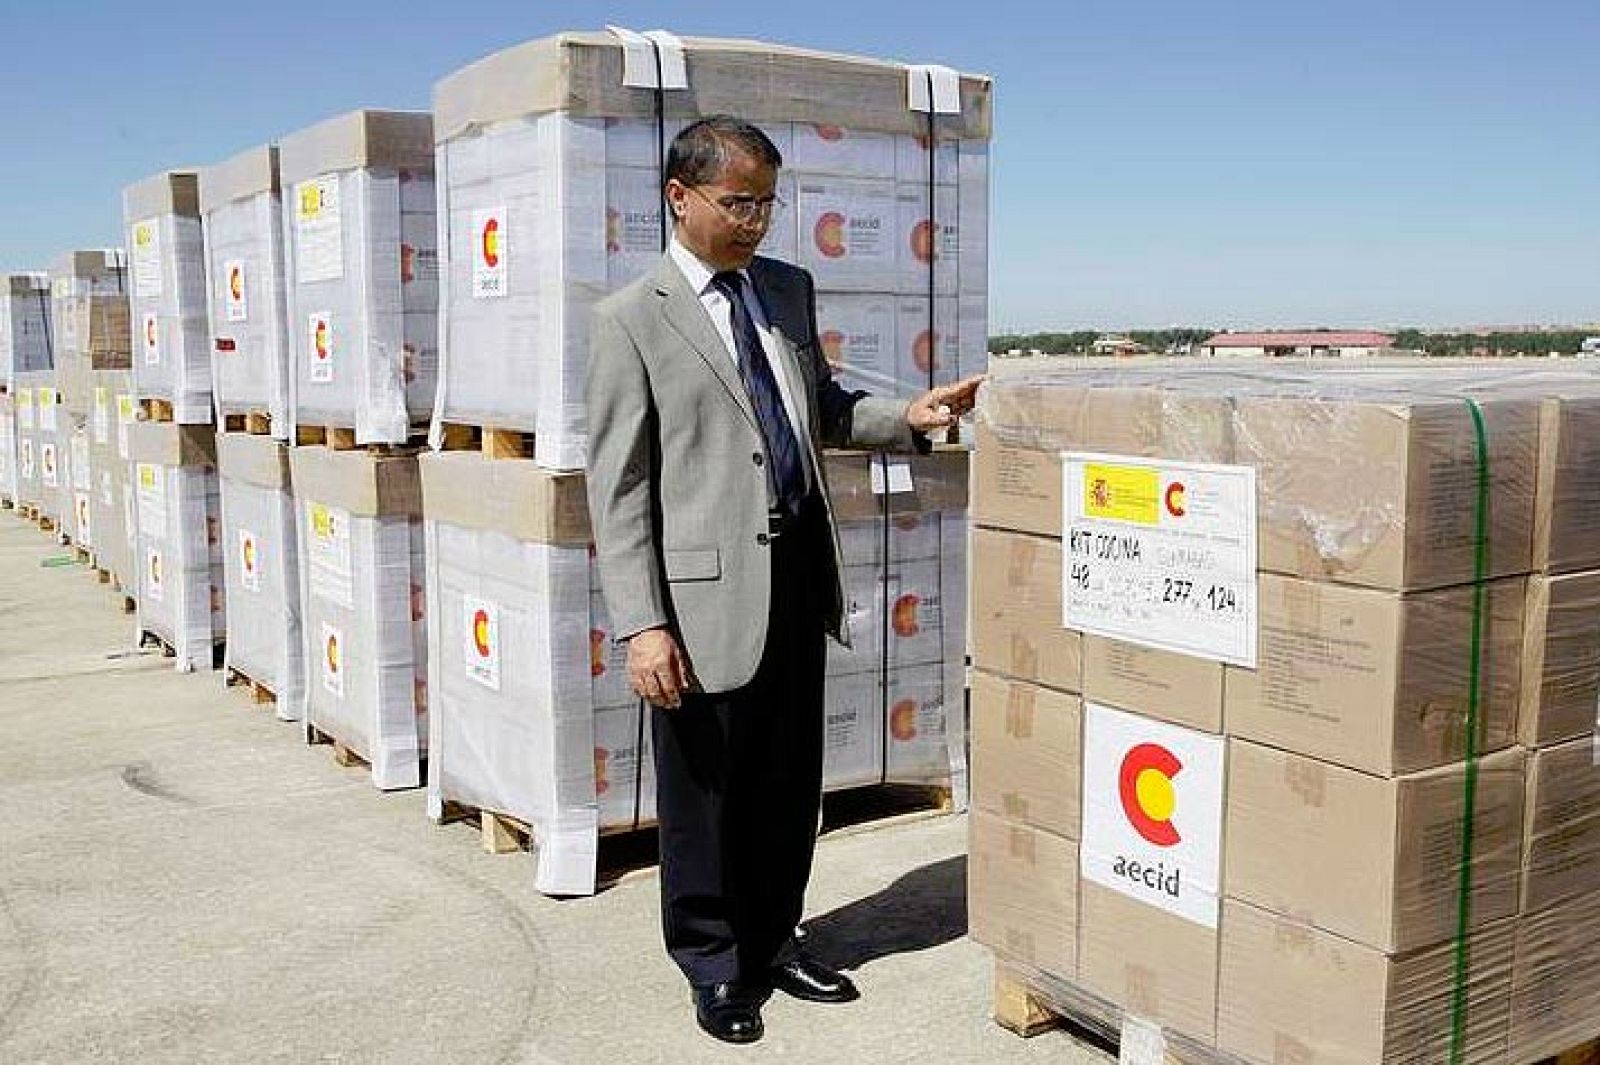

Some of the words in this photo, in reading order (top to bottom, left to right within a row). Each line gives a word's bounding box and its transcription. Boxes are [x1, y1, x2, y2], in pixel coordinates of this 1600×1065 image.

[1163, 577, 1193, 602] 277
[1207, 584, 1236, 612] 124
[1113, 855, 1180, 898] aecid
